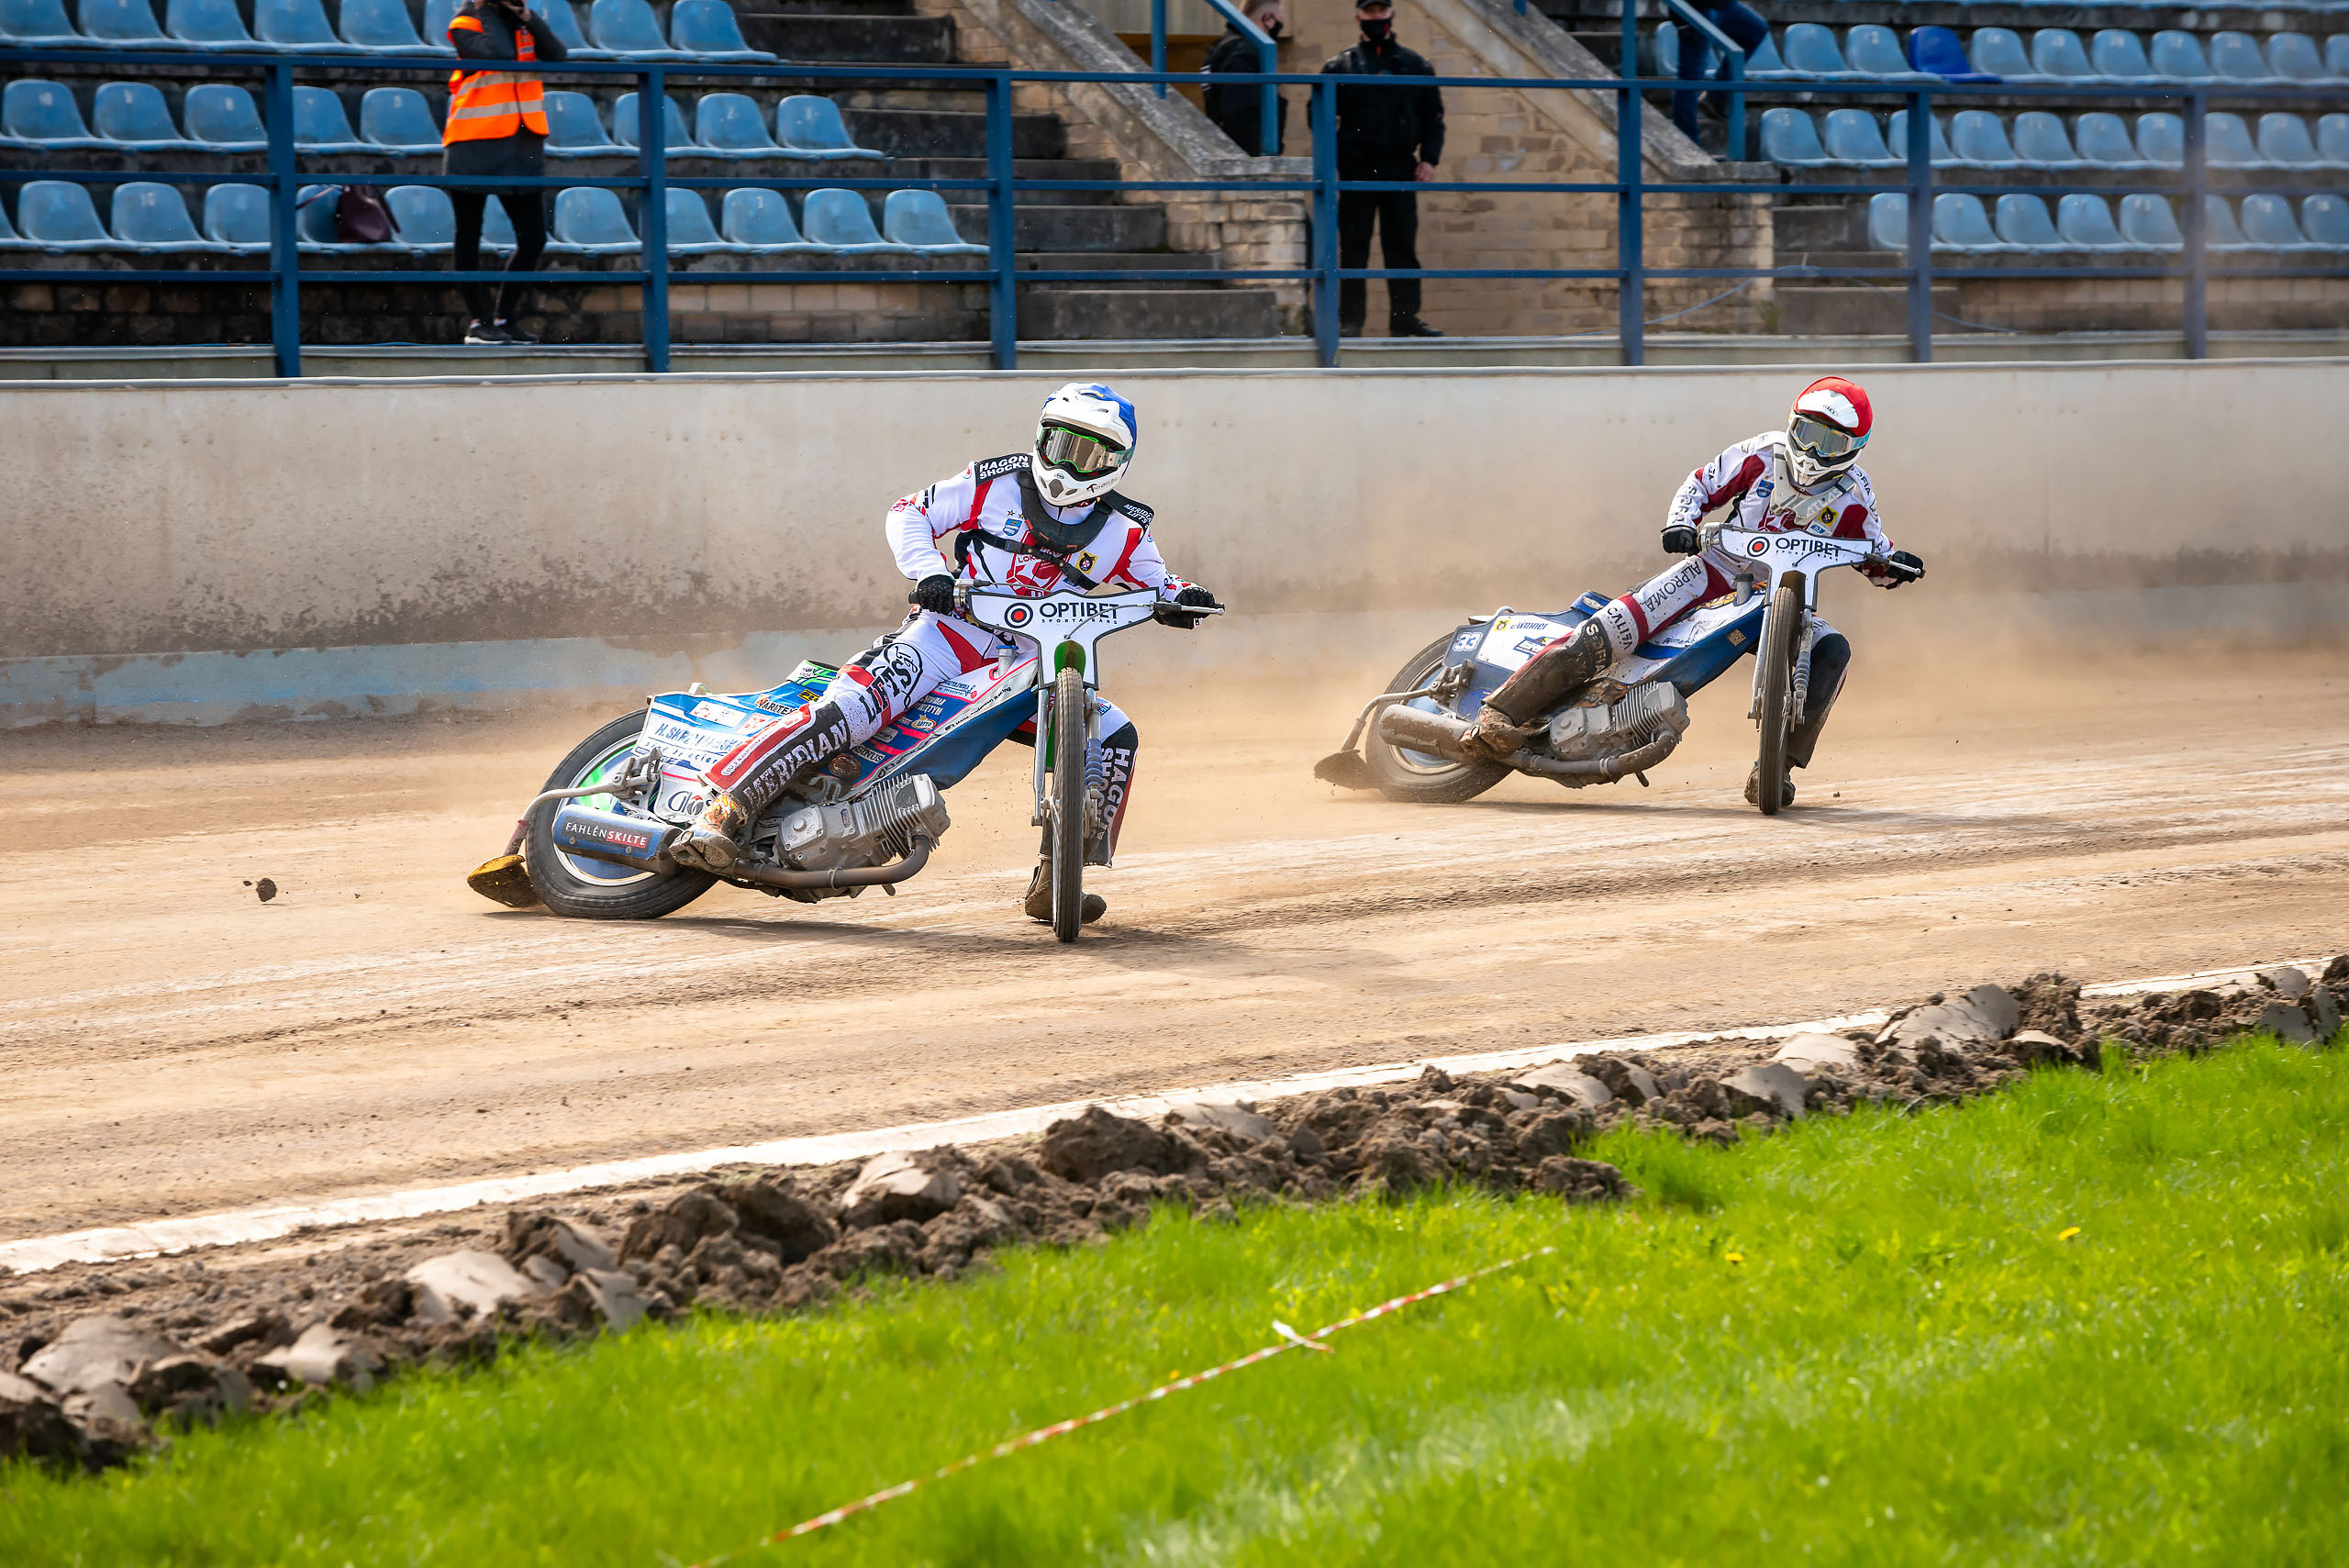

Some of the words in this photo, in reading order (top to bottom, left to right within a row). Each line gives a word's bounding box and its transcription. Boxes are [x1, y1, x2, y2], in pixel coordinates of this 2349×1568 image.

[979, 455, 1029, 473] HAGON
[979, 462, 1030, 480] SHOCKS
[1775, 537, 1842, 558] OPTIBET
[1643, 560, 1702, 613] ALPROMA
[1039, 601, 1119, 619] OPTIBET
[1453, 631, 1484, 652] 33
[858, 658, 912, 726] LIFTS
[742, 718, 849, 810] MERIDIAN
[1097, 747, 1130, 840] HAGON
